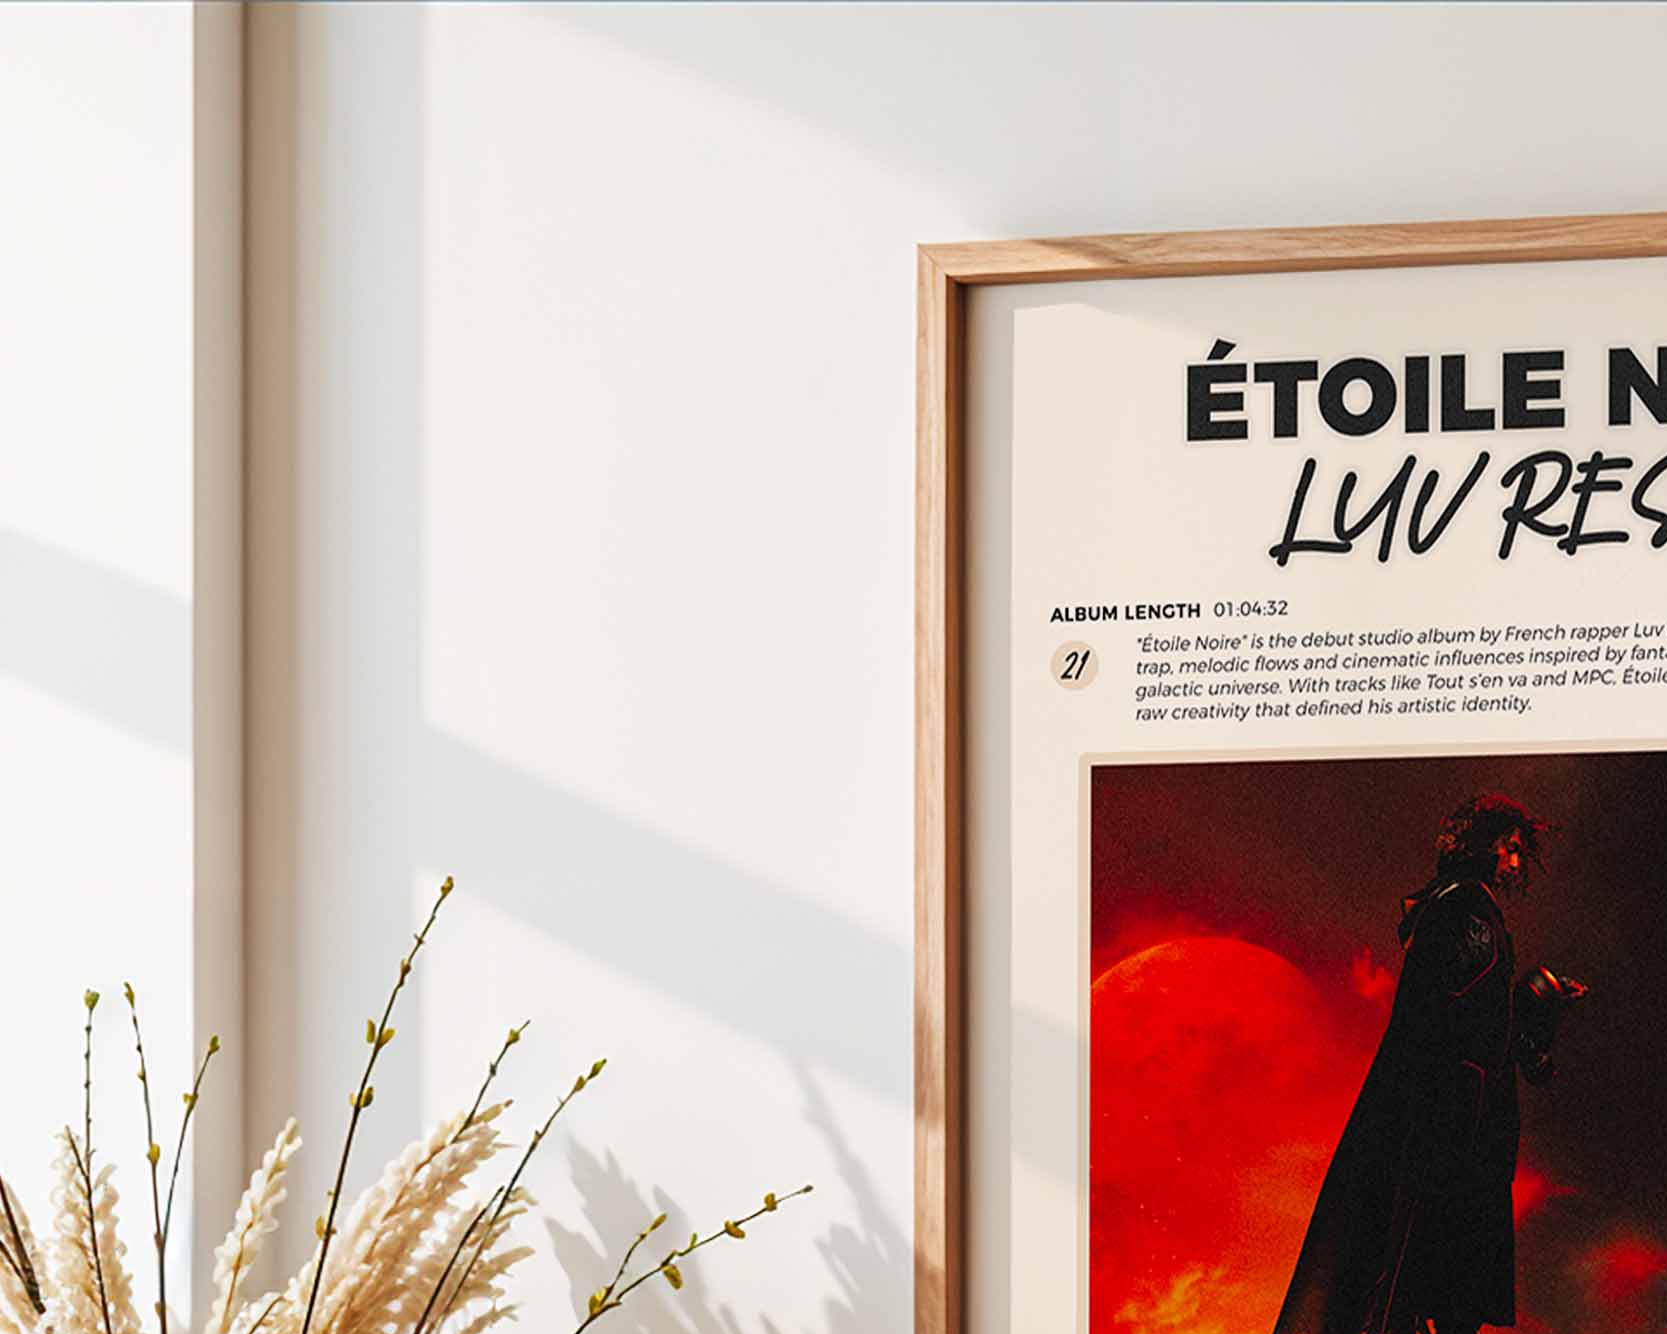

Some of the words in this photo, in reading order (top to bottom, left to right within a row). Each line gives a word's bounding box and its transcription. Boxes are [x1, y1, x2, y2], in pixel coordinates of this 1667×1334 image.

[1186, 338, 1566, 442] ÉTOILE
[1268, 451, 1491, 567] LUV
[1050, 605, 1117, 623] ALBUM
[1125, 603, 1200, 620] LENGTH
[1214, 600, 1288, 617] 01:04:32
[1251, 633, 1263, 649] is
[1269, 633, 1297, 648] the
[1301, 632, 1354, 648] debut
[1359, 629, 1413, 646] studio
[1417, 628, 1475, 645] album
[1480, 627, 1501, 646] by
[1505, 624, 1565, 641] French
[1570, 626, 1629, 642] rapper
[1634, 623, 1664, 638] Luv
[1061, 650, 1090, 680] 21
[1137, 662, 1173, 677] trap,
[1179, 656, 1249, 673] melodic
[1255, 655, 1298, 672] flows
[1303, 653, 1338, 670] and
[1342, 651, 1429, 669] cinematic
[1434, 649, 1524, 666] influences
[1529, 646, 1600, 666] inspired
[1605, 646, 1627, 665] by
[1136, 681, 1203, 702] galactic
[1208, 680, 1282, 696] universe.
[1289, 677, 1329, 693] With
[1336, 676, 1386, 692] tracks
[1391, 675, 1421, 690] like
[1427, 674, 1464, 690] Tout
[1509, 675, 1527, 687] va
[1532, 670, 1567, 687] and
[1572, 669, 1616, 685] MPC,
[1136, 709, 1168, 720] raw
[1171, 702, 1250, 722] creativity
[1256, 702, 1290, 718] that
[1296, 699, 1363, 716] defined
[1368, 698, 1392, 714] his
[1398, 697, 1456, 714] artistic
[1462, 695, 1531, 714] identity.
